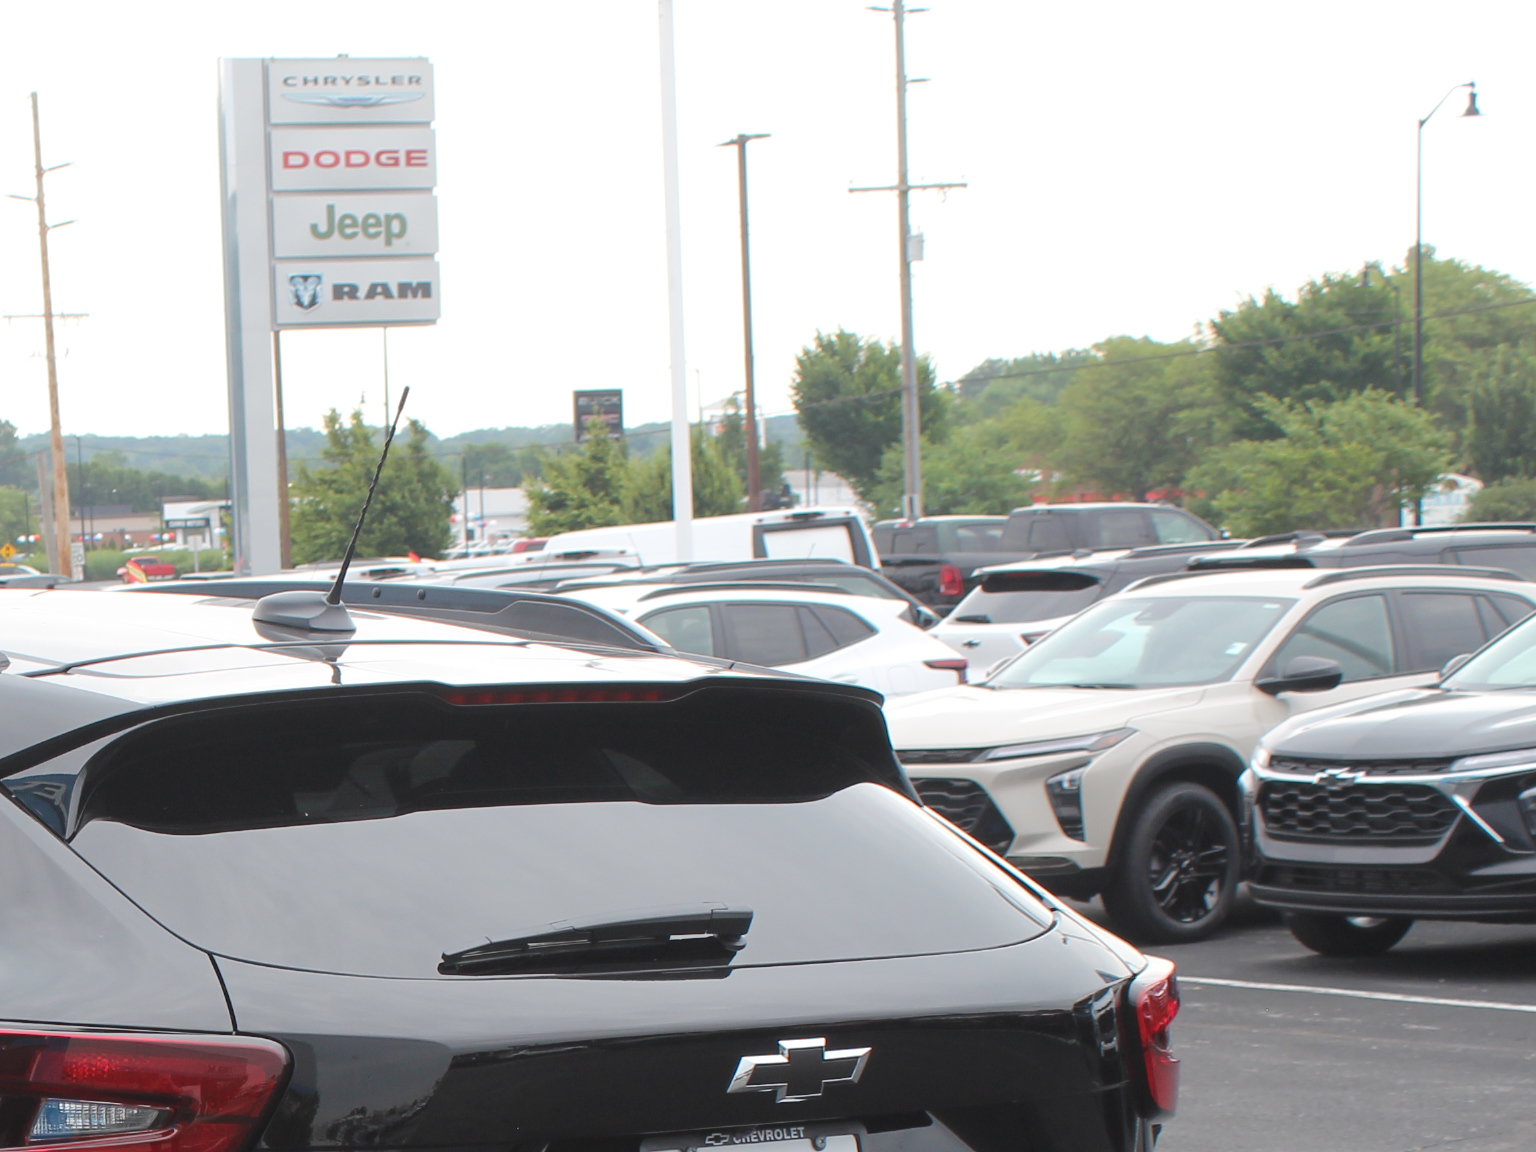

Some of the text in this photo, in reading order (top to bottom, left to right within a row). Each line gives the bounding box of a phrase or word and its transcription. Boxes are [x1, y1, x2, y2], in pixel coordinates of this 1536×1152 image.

[282, 75, 424, 87] CHRYSLER
[282, 149, 429, 169] DODGE
[309, 203, 408, 247] Jeep
[332, 281, 432, 301] RAM
